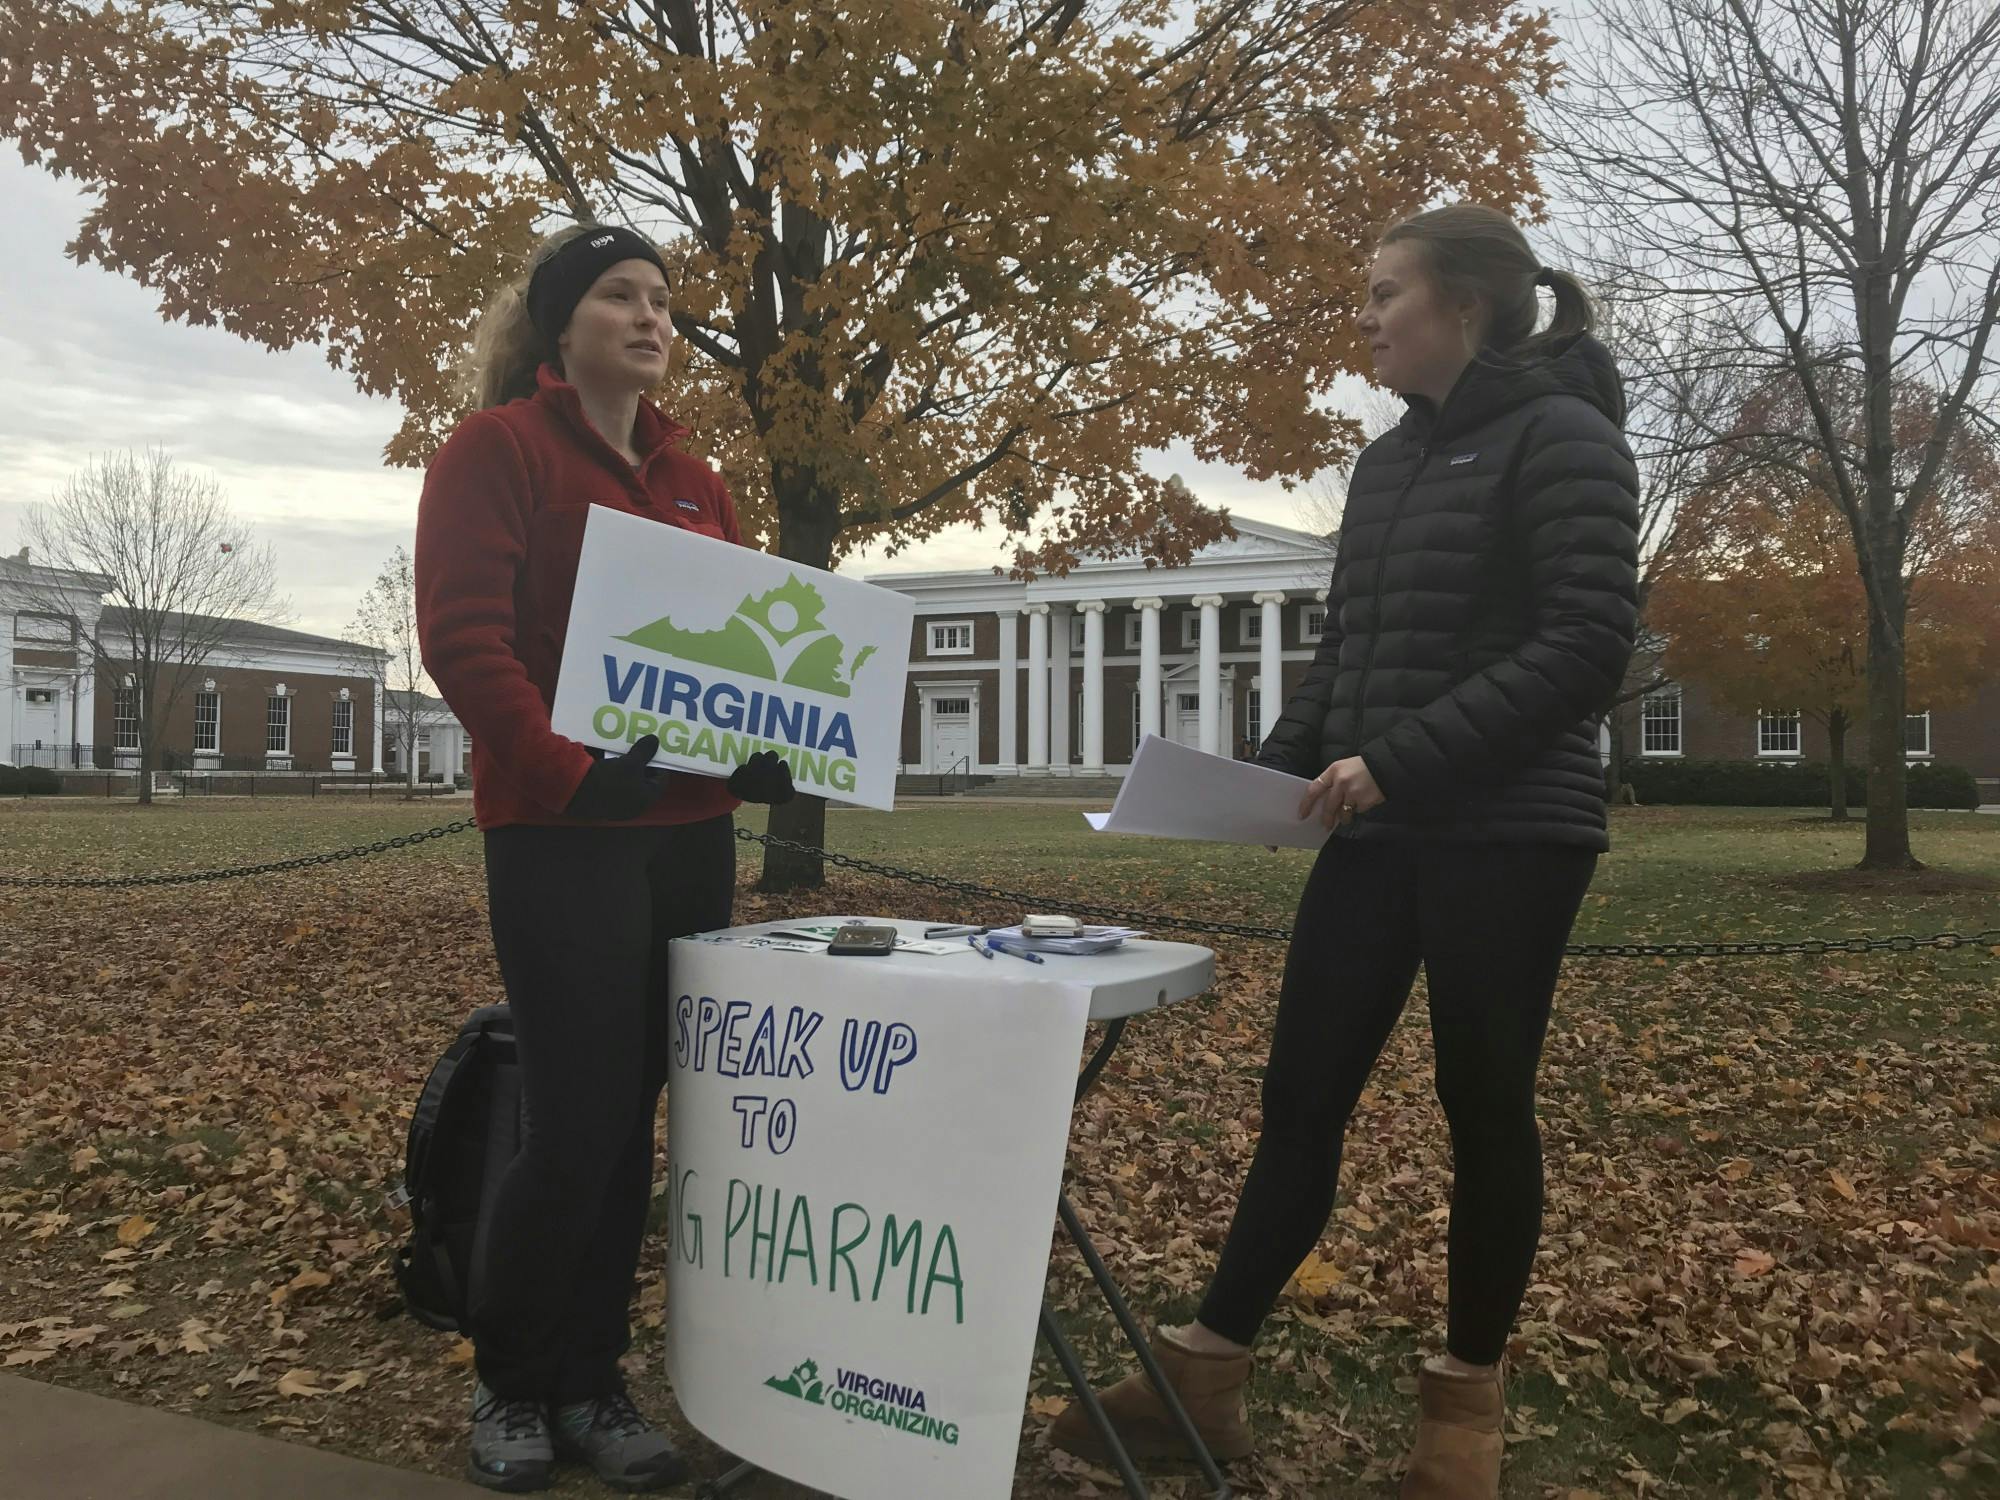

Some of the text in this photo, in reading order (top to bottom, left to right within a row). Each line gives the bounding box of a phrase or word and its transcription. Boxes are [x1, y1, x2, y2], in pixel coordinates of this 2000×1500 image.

[602, 653, 858, 759] VIRGINIA
[674, 994, 918, 1095] SPEAK UP
[732, 1095, 797, 1155] TO
[669, 1162, 964, 1325] IG PHARMA
[831, 1389, 960, 1446] ORGANIZING
[837, 1367, 927, 1413] VIRGINIA
